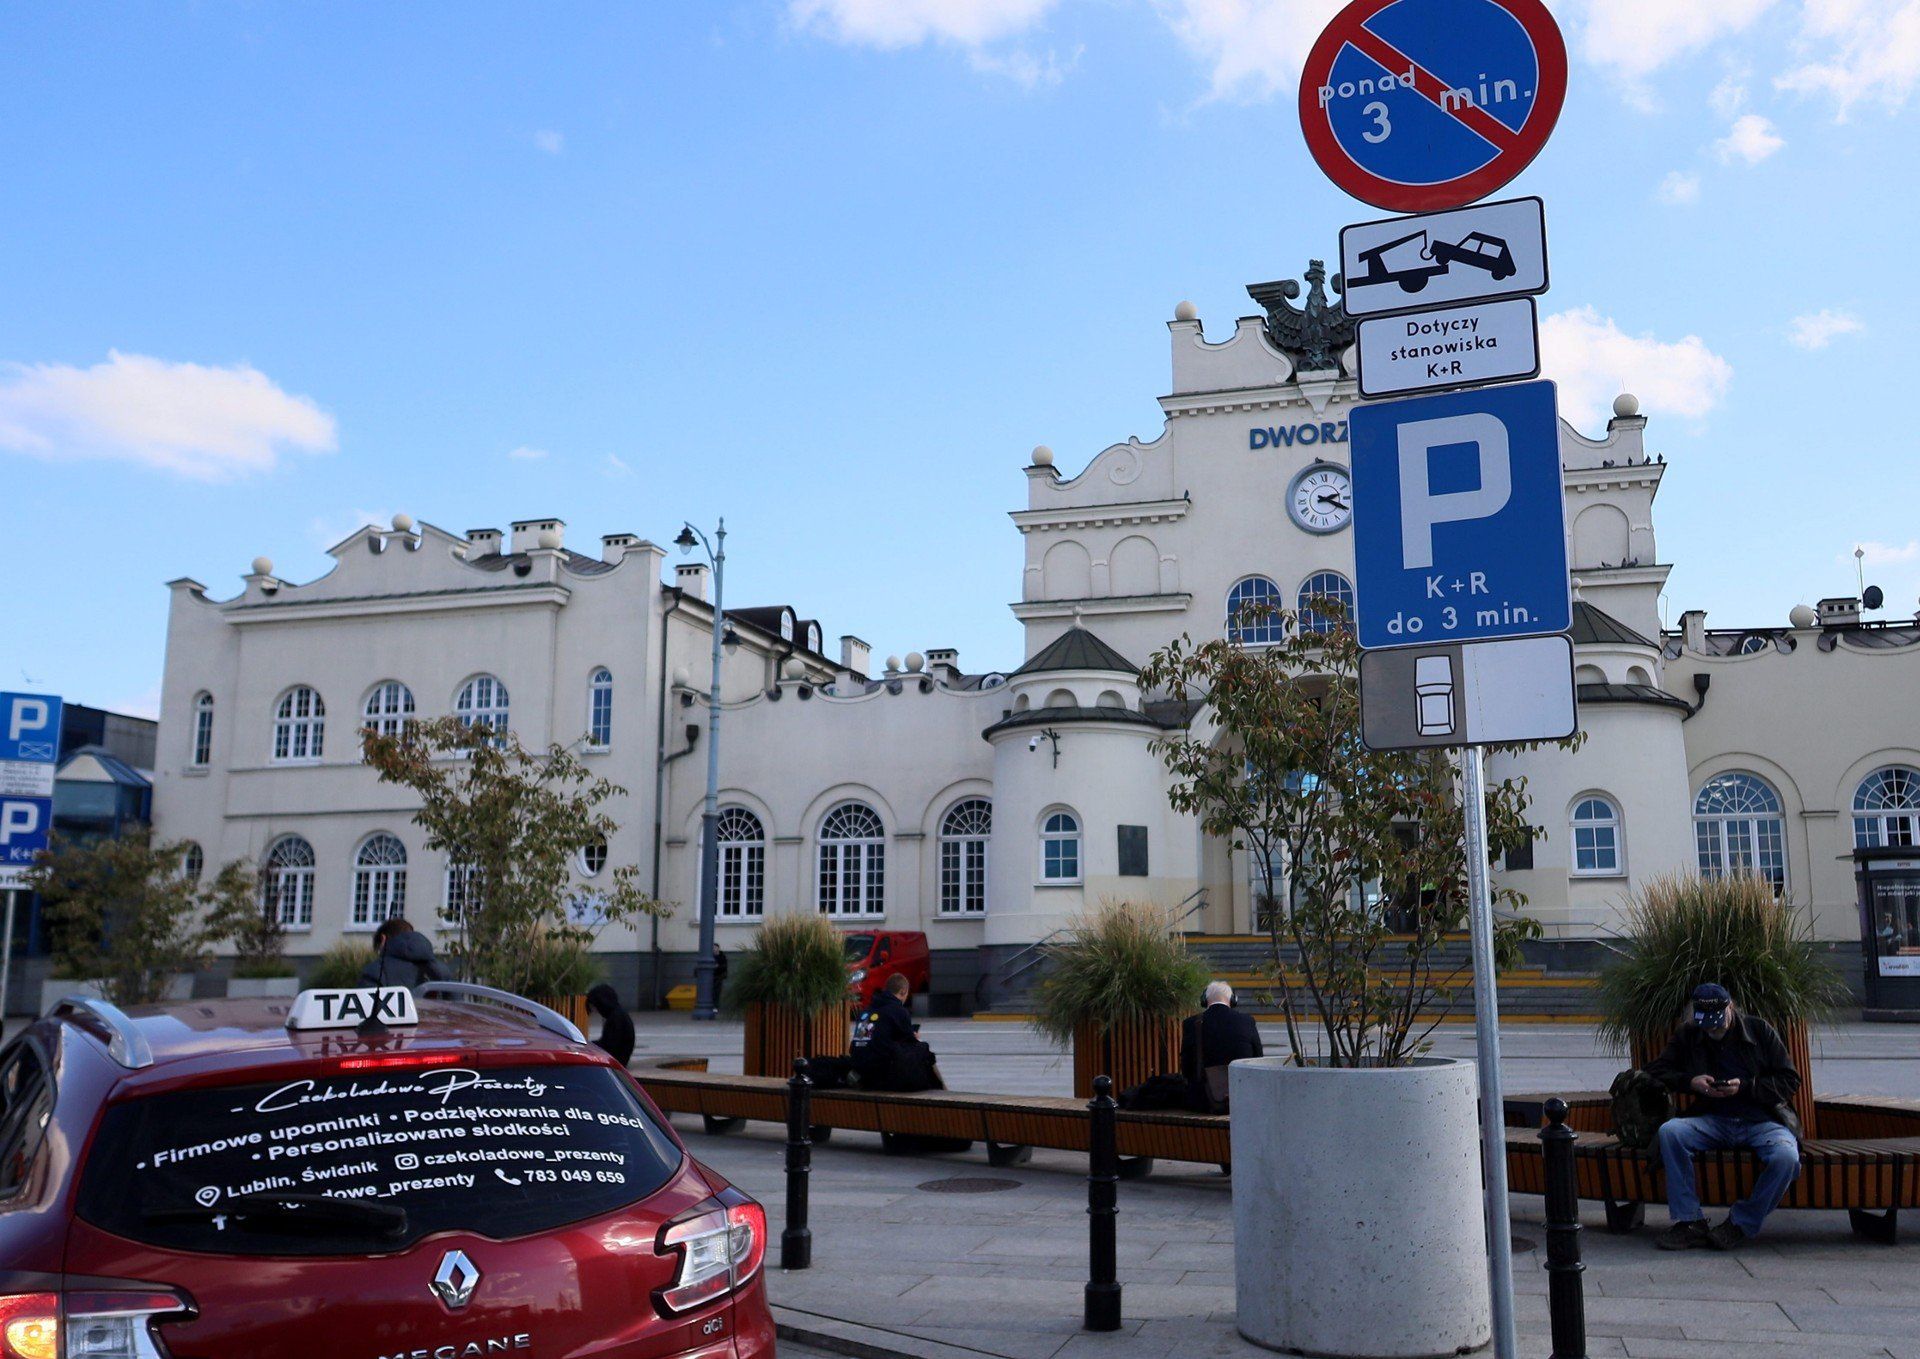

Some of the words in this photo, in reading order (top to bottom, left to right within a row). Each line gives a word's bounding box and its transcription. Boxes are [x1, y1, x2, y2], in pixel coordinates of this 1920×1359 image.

[1317, 65, 1417, 109] ponad
[1361, 101, 1392, 144] 3
[1440, 73, 1532, 112] min.
[1406, 316, 1480, 338] Dotyczy
[1390, 335, 1498, 361] stanowiska
[1426, 360, 1463, 379] K+R
[1249, 420, 1349, 450] DWORZ
[1396, 412, 1513, 570] P
[1426, 571, 1490, 599] K+R
[1387, 611, 1423, 635] do
[1441, 606, 1458, 630] 3
[1476, 601, 1539, 627] min.
[9, 699, 48, 741] P
[313, 991, 406, 1021] TAXI
[254, 1079, 425, 1113] Czekoladowe
[419, 1068, 548, 1105] Prezenty
[153, 1132, 263, 1168] Firmowe
[269, 1112, 381, 1141] upominki
[403, 1105, 560, 1123] Podziękowania
[564, 1107, 593, 1121] dla
[597, 1111, 645, 1130] gości
[267, 1124, 467, 1161] Personalizowane
[471, 1122, 570, 1138] słodkości
[423, 1148, 626, 1166] czekoladowe_prezenty
[226, 1175, 297, 1199] Lublin,
[300, 1160, 379, 1183] Świdnik
[523, 1169, 557, 1184] 783
[561, 1169, 592, 1183] 049
[596, 1170, 626, 1184] 659
